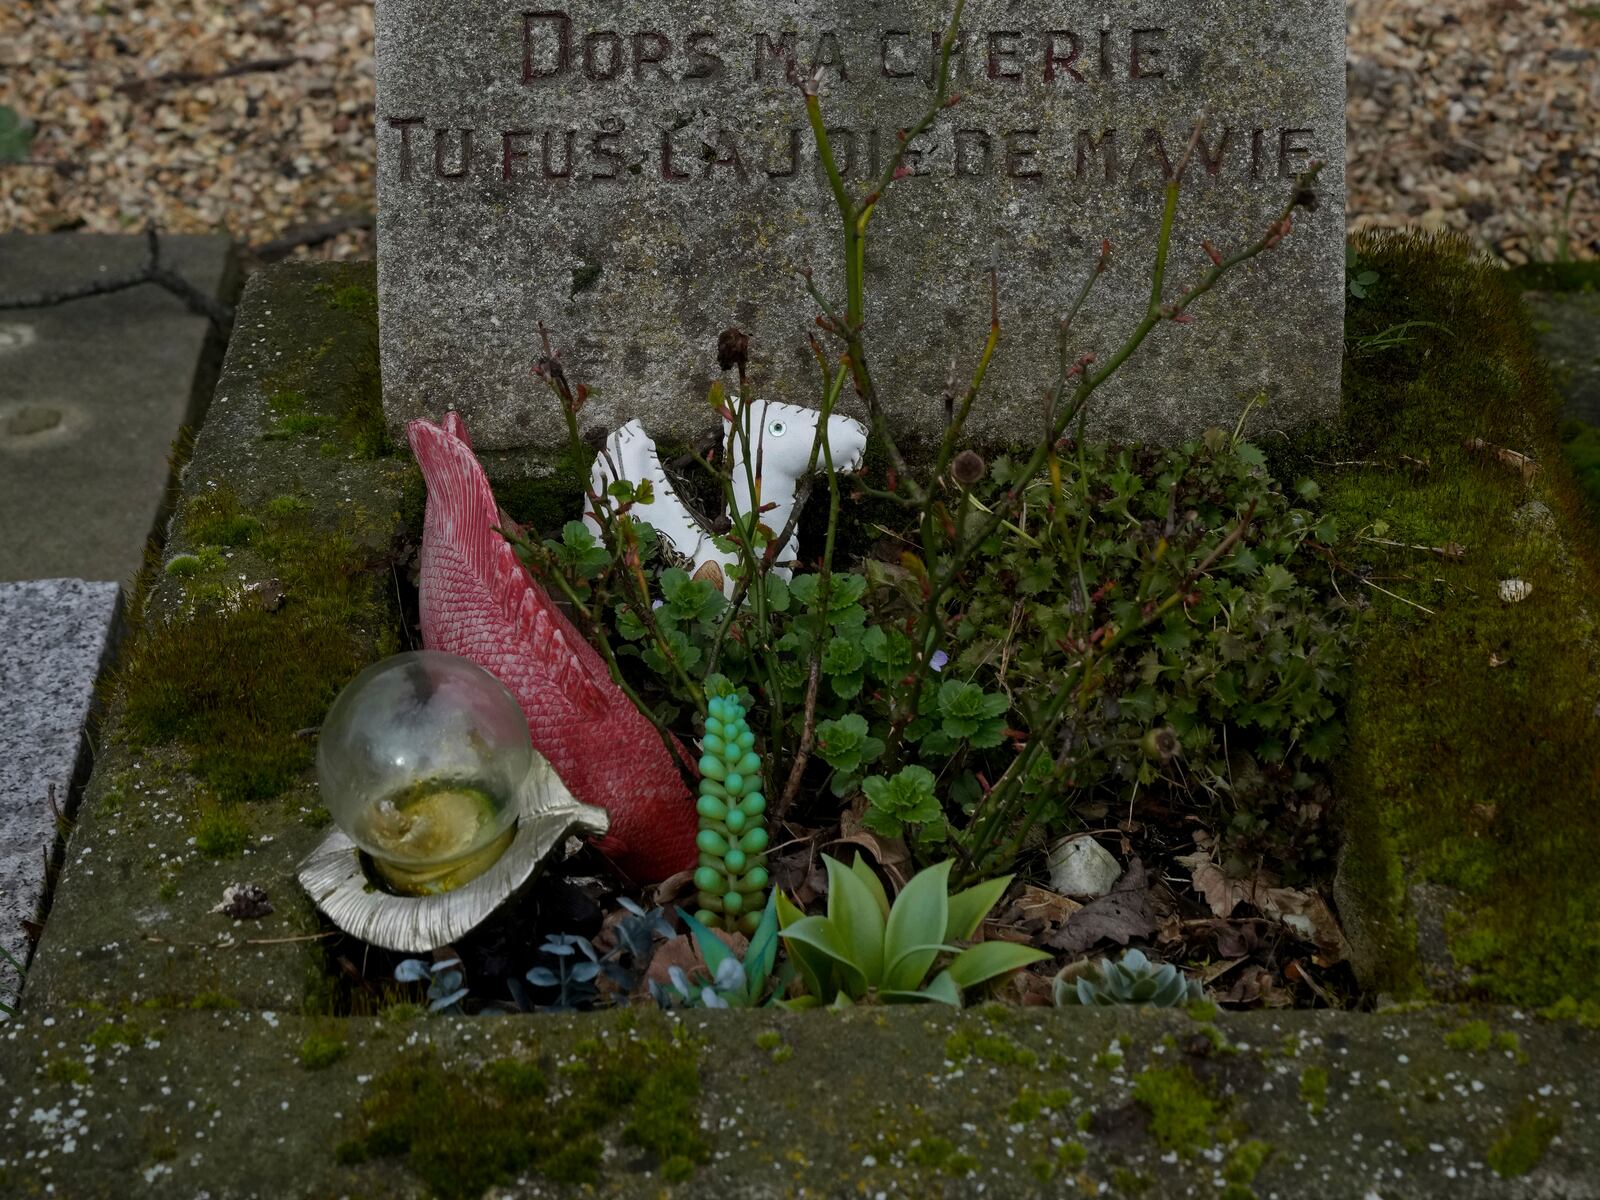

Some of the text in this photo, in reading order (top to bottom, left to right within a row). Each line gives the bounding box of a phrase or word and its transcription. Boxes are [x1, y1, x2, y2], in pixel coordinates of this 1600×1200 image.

[521, 9, 1167, 86] DORS MA CHERIE
[386, 115, 474, 184] TU
[501, 129, 624, 181] FUS
[662, 129, 748, 184] LA
[953, 128, 1044, 181] DE
[1074, 127, 1175, 182] MA
[1190, 127, 1316, 182] VIE
